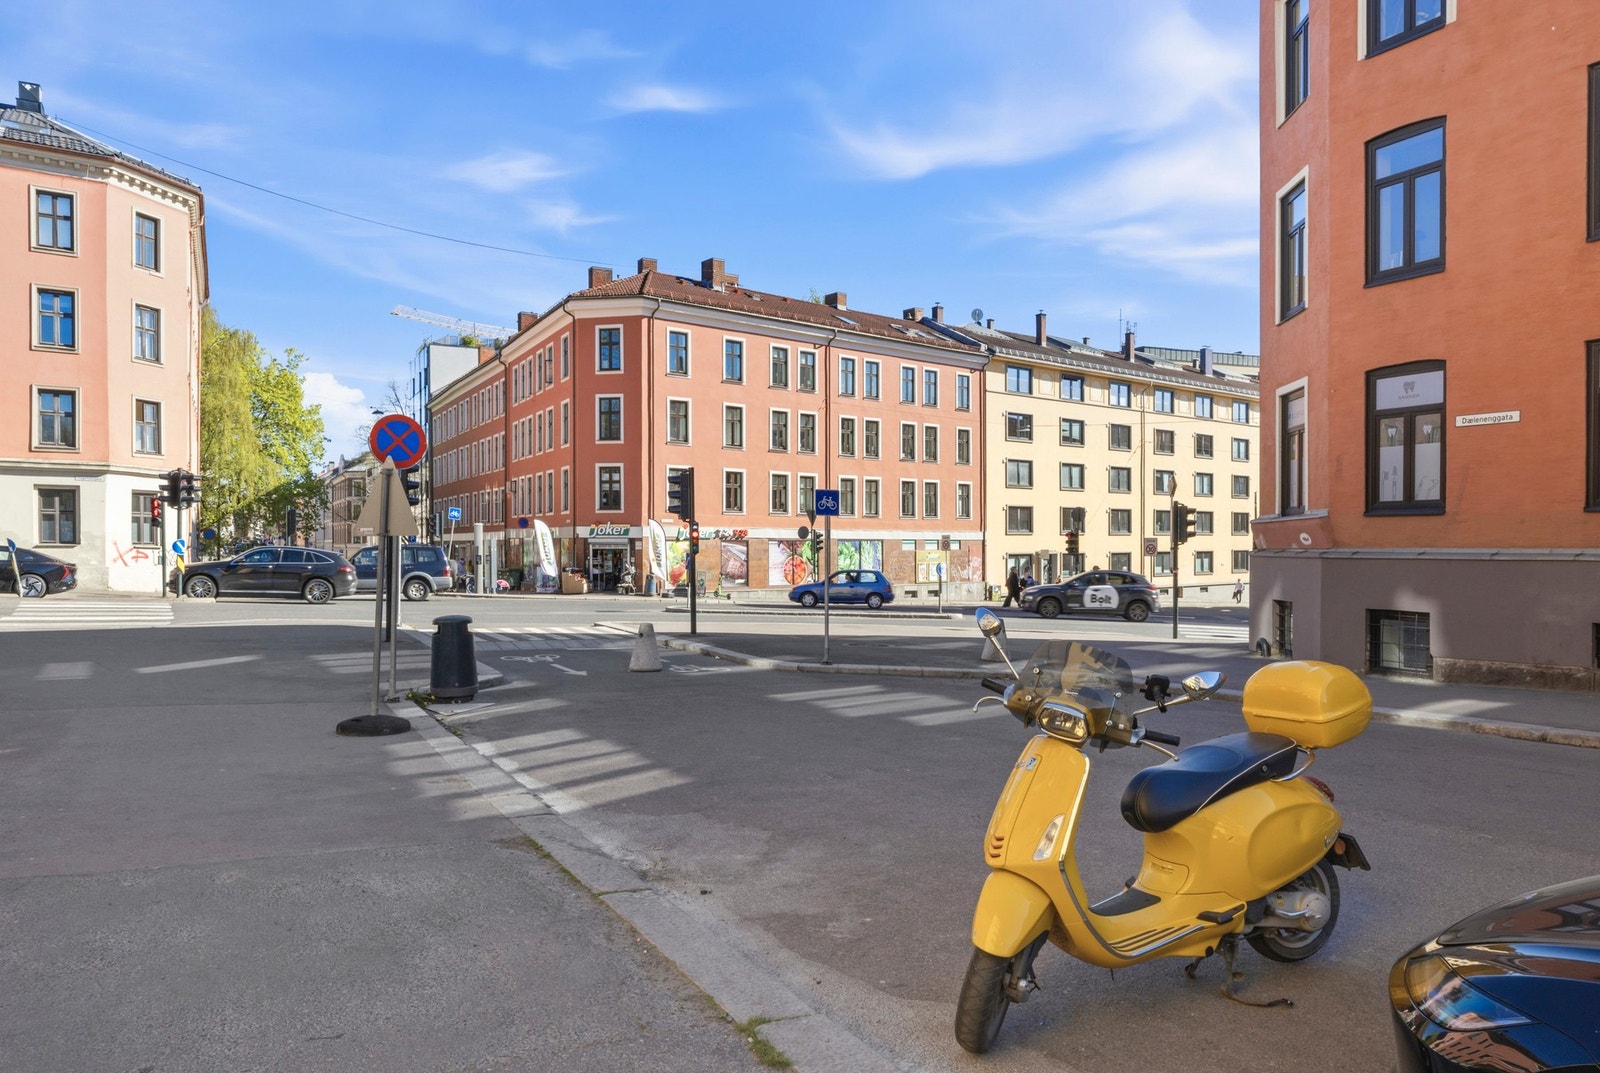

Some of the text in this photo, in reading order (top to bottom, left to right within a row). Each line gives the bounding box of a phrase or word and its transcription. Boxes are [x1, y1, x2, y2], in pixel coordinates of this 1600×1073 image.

[1461, 414, 1513, 424] Dælenenggata
[589, 521, 627, 537] joker
[1090, 593, 1112, 604] Bolt
